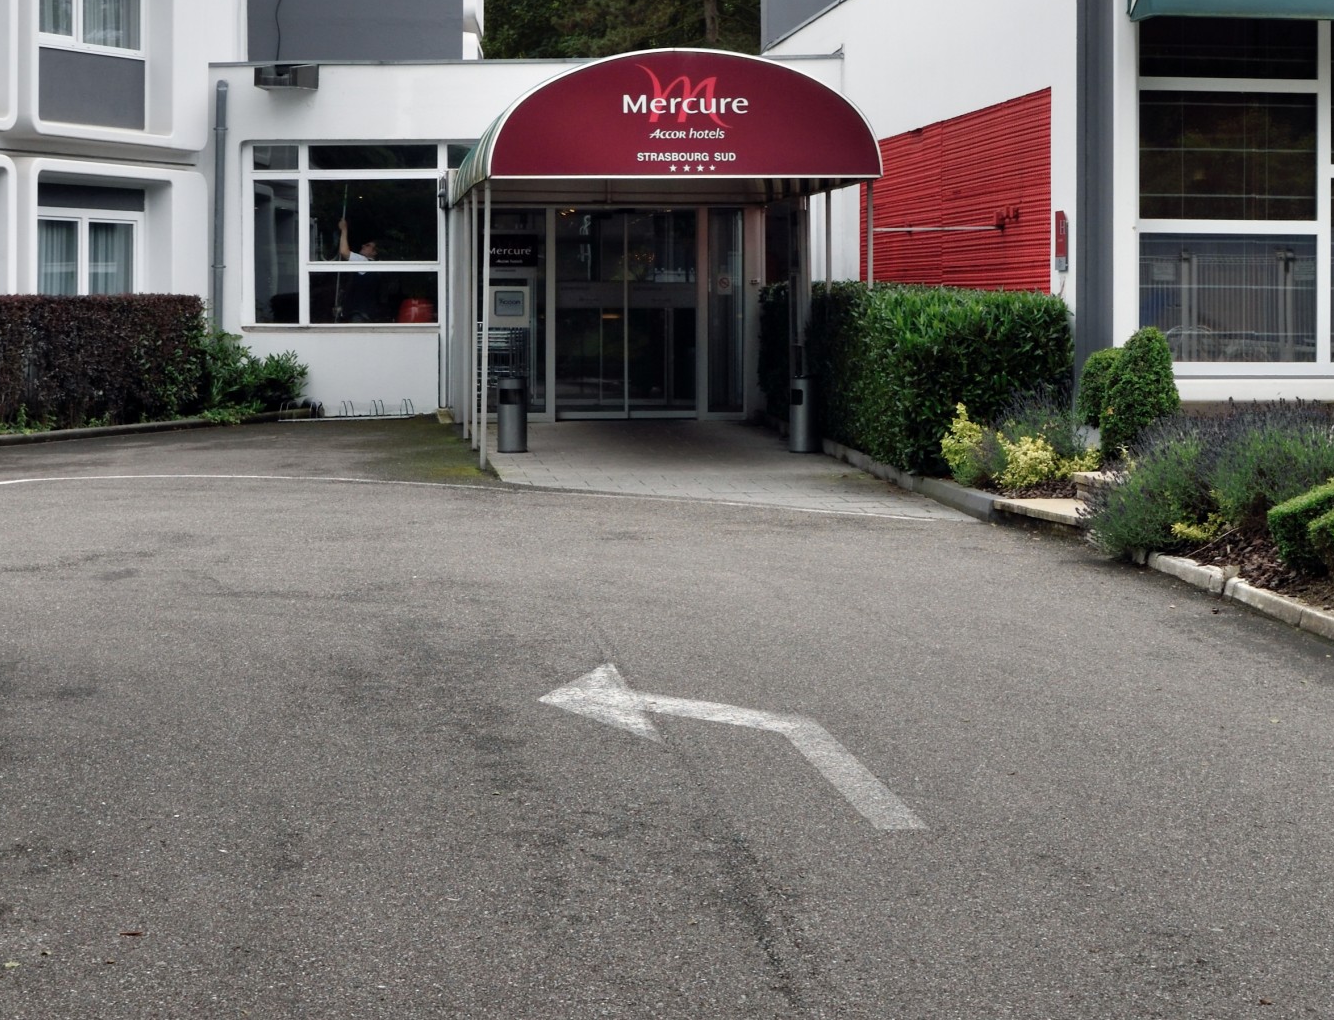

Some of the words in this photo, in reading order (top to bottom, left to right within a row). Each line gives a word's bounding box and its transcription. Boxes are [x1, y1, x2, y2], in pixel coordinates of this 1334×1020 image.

[622, 94, 749, 114] Mercure
[689, 127, 725, 139] hotels
[637, 152, 709, 161] STRASBOURG
[714, 152, 736, 161] SUD
